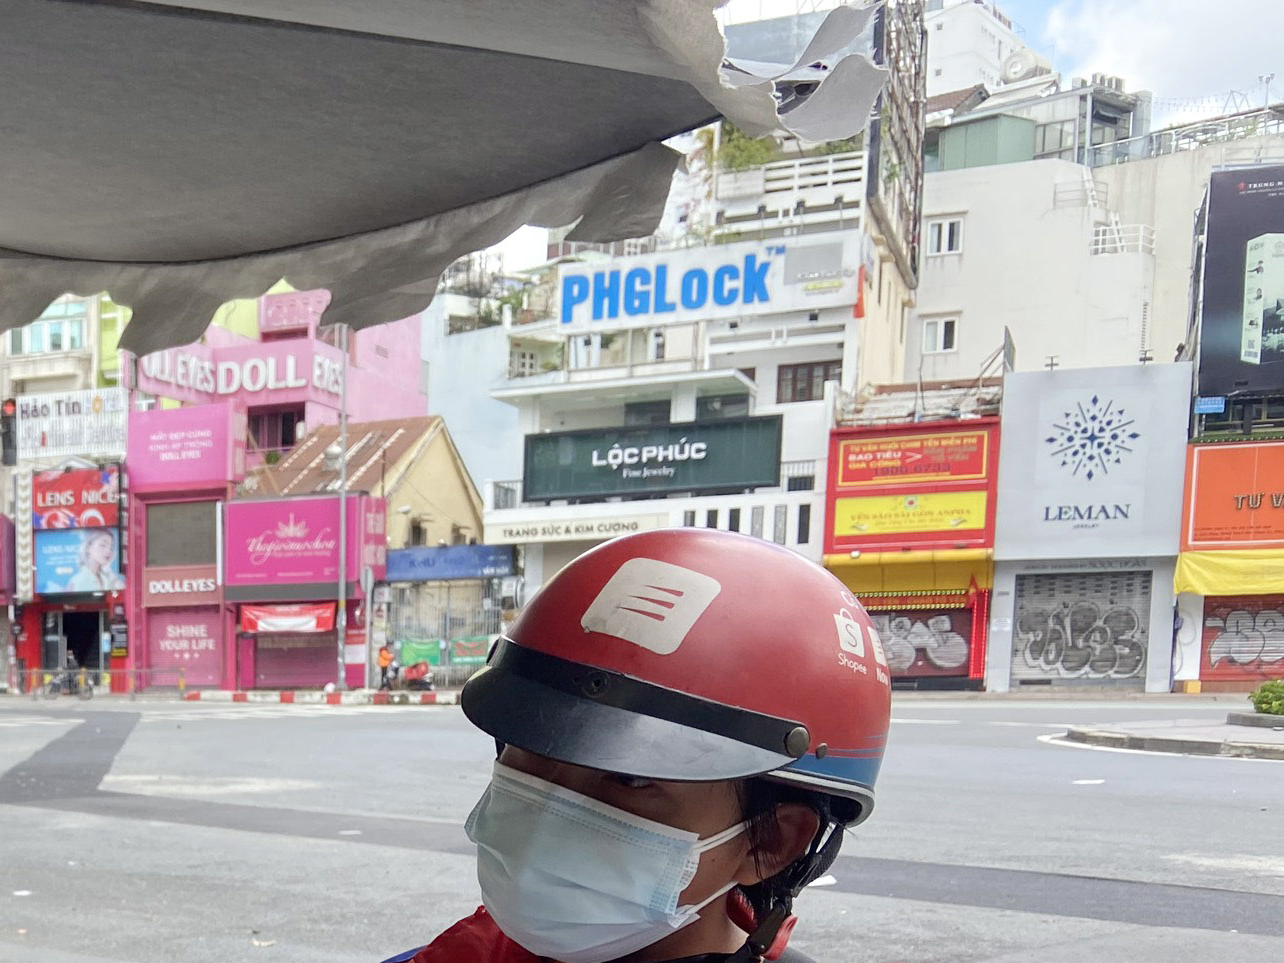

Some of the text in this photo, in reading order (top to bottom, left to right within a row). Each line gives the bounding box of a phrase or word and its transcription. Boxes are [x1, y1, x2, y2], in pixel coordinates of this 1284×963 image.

[177, 353, 216, 394] EYES
[216, 354, 308, 395] DOLL
[592, 436, 708, 470] LỘC PHÚC
[848, 453, 873, 462] BAO
[623, 467, 642, 478] Fine
[37, 490, 75, 508] LENS
[1234, 492, 1266, 510] TƯ
[1044, 504, 1132, 522] LEMAN
[503, 526, 540, 538] TRANG
[564, 524, 572, 534] &
[575, 522, 595, 534] KIM
[148, 578, 216, 594] DOLLEYES
[167, 624, 208, 638] SHINE
[159, 638, 216, 651] YOUR LIFE
[838, 652, 867, 675] Shopee
